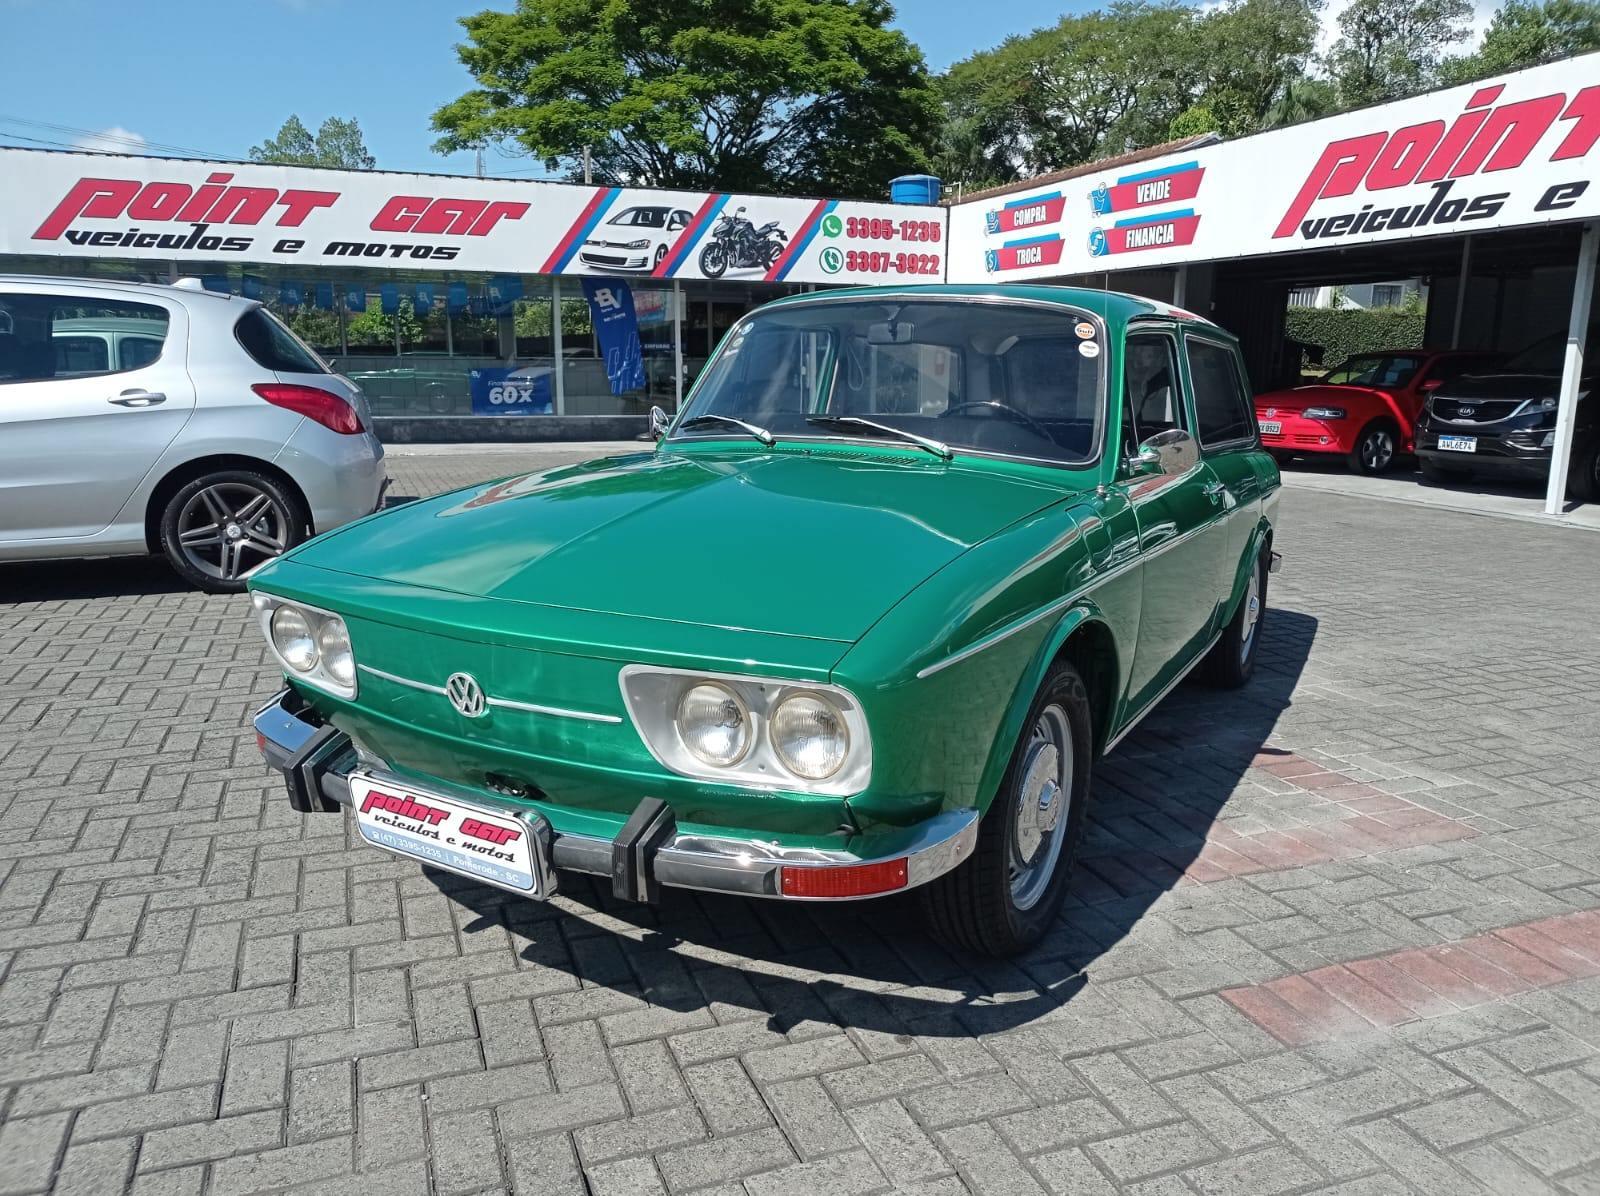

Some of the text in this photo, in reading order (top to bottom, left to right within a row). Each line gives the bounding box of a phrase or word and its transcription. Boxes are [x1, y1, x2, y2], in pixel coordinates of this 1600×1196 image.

[1137, 179, 1171, 204] VENDE
[1014, 205, 1047, 227] COMPRA
[1300, 179, 1590, 240] veiculos e
[65, 223, 461, 260] veiculos e motos
[846, 217, 941, 242] 3395-1235
[1125, 223, 1174, 249] FINANCIA
[846, 250, 940, 275] 3387-3922
[1016, 247, 1042, 265] TROCA
[489, 386, 533, 405] 60x
[374, 813, 515, 863] veiculos e motos
[379, 833, 397, 846] (47)
[506, 873, 520, 882] SC
